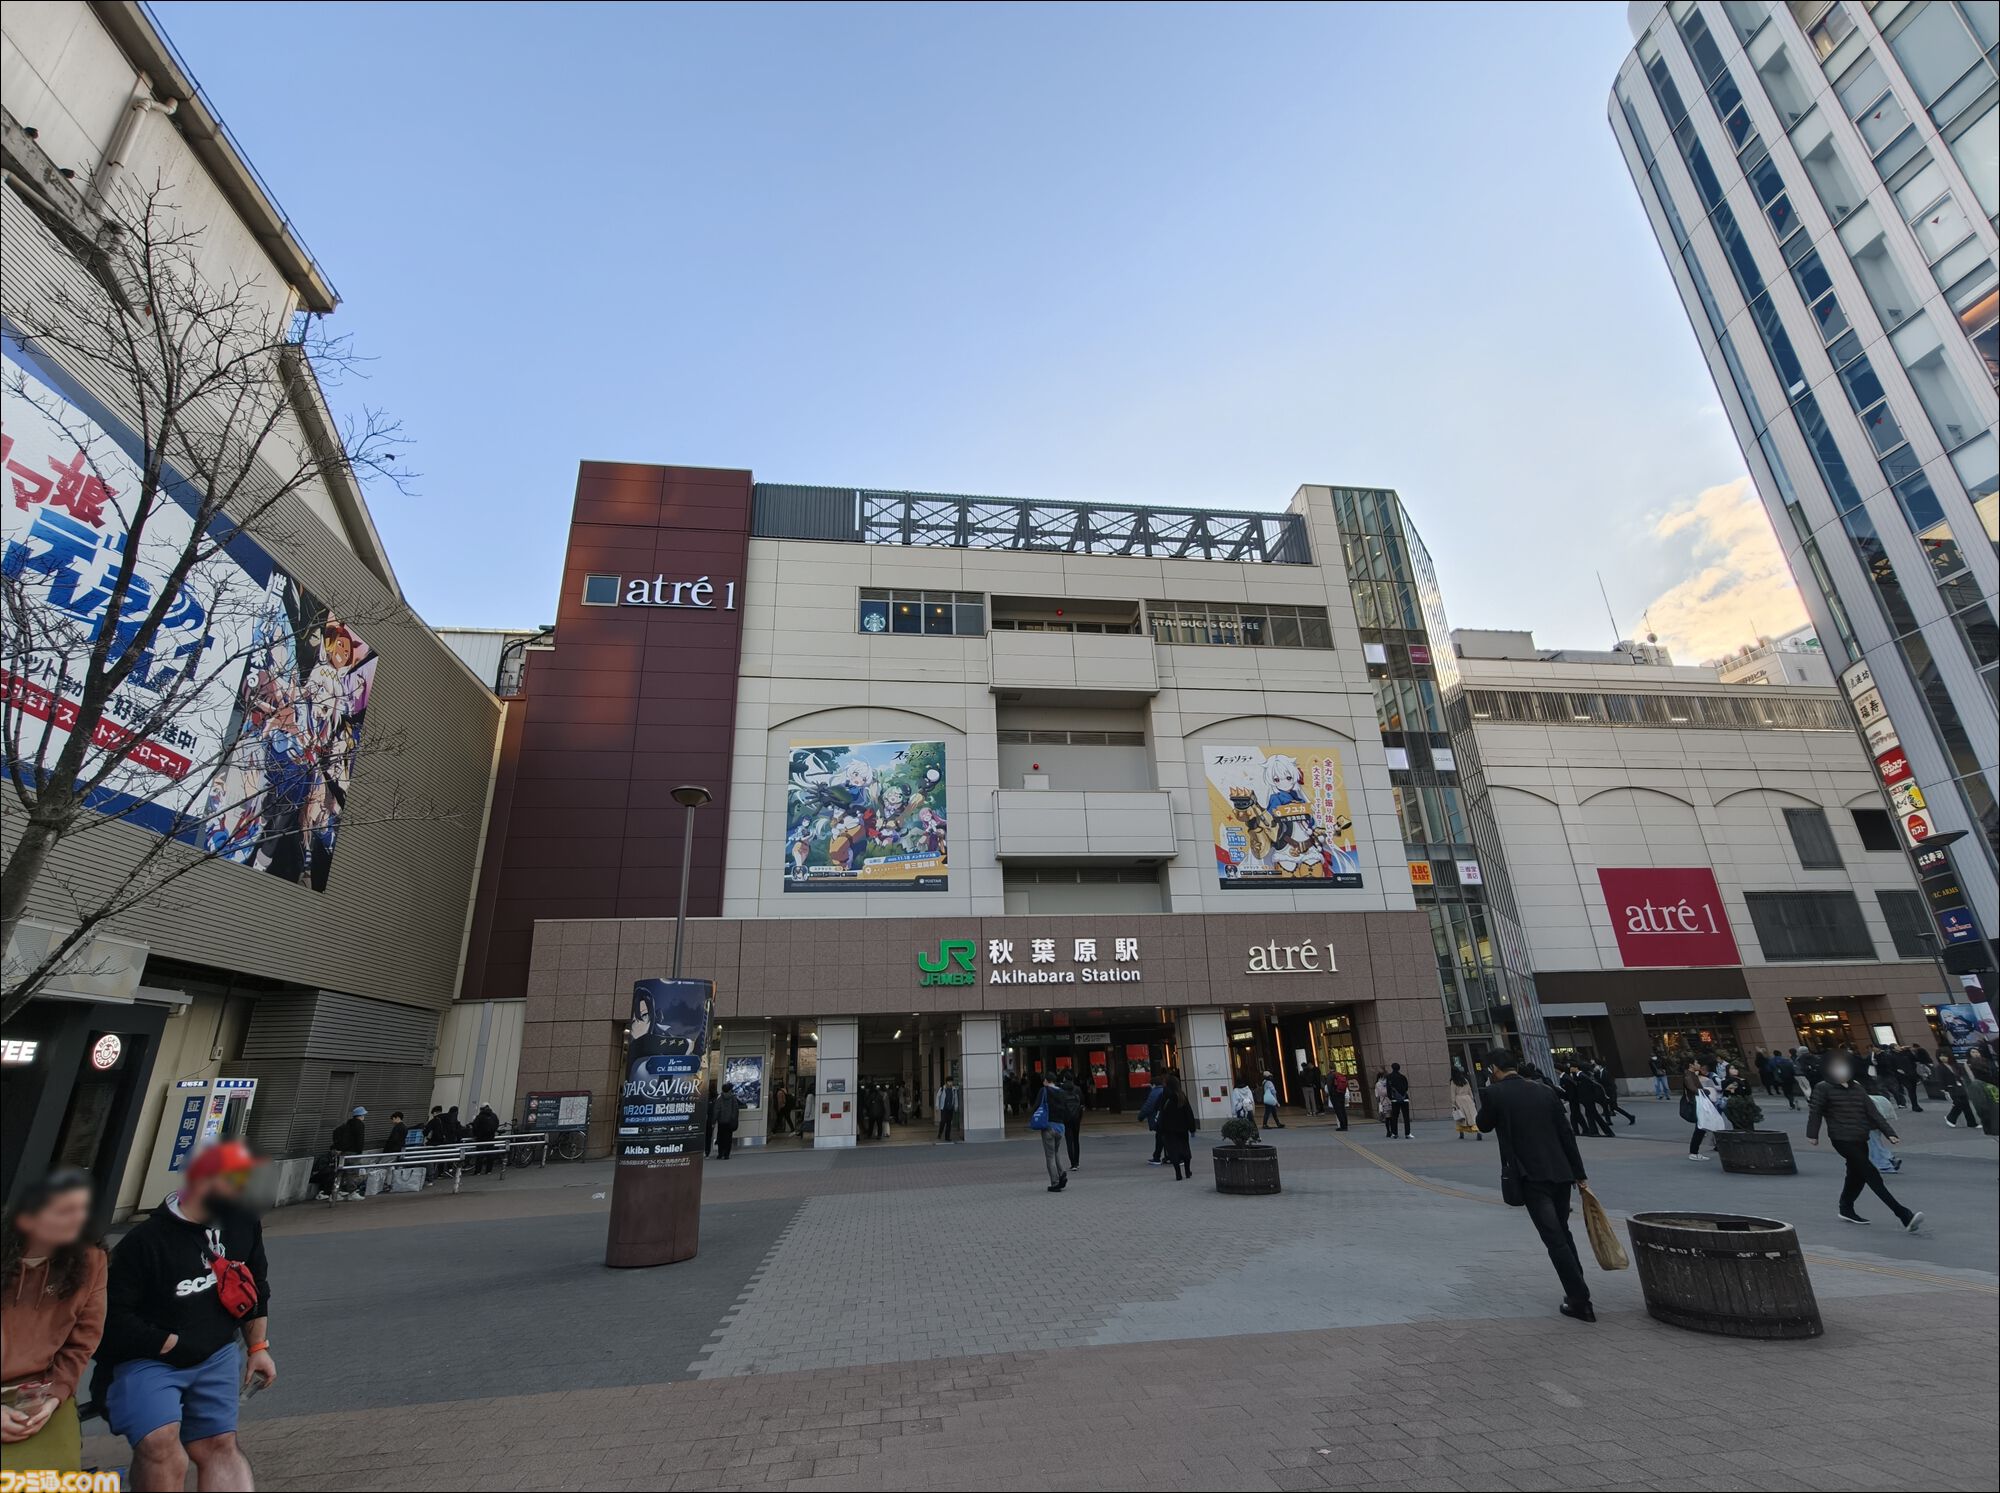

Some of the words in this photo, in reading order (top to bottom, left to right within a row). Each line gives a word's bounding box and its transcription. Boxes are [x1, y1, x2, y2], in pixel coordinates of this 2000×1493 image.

[0, 430, 120, 529] マ娘
[620, 574, 716, 608] atré
[723, 582, 737, 610] 1
[1214, 754, 1249, 765] ステラソラ
[1918, 850, 1944, 866] はま寿司
[1411, 864, 1429, 875] ABC
[1625, 899, 1704, 934] atré
[1702, 904, 1721, 934] 1
[918, 939, 976, 972] JR
[989, 938, 1139, 964] 秋葉原駅
[1246, 938, 1323, 973] atré
[1325, 943, 1339, 972] 1
[920, 973, 975, 986] JR東日本
[989, 970, 1075, 984] Akihabara
[1081, 968, 1141, 982] Station
[623, 1080, 656, 1099] STAR
[646, 1077, 702, 1097] SAVIOR
[624, 1146, 650, 1155] Akiba
[654, 1143, 684, 1154] Smile!
